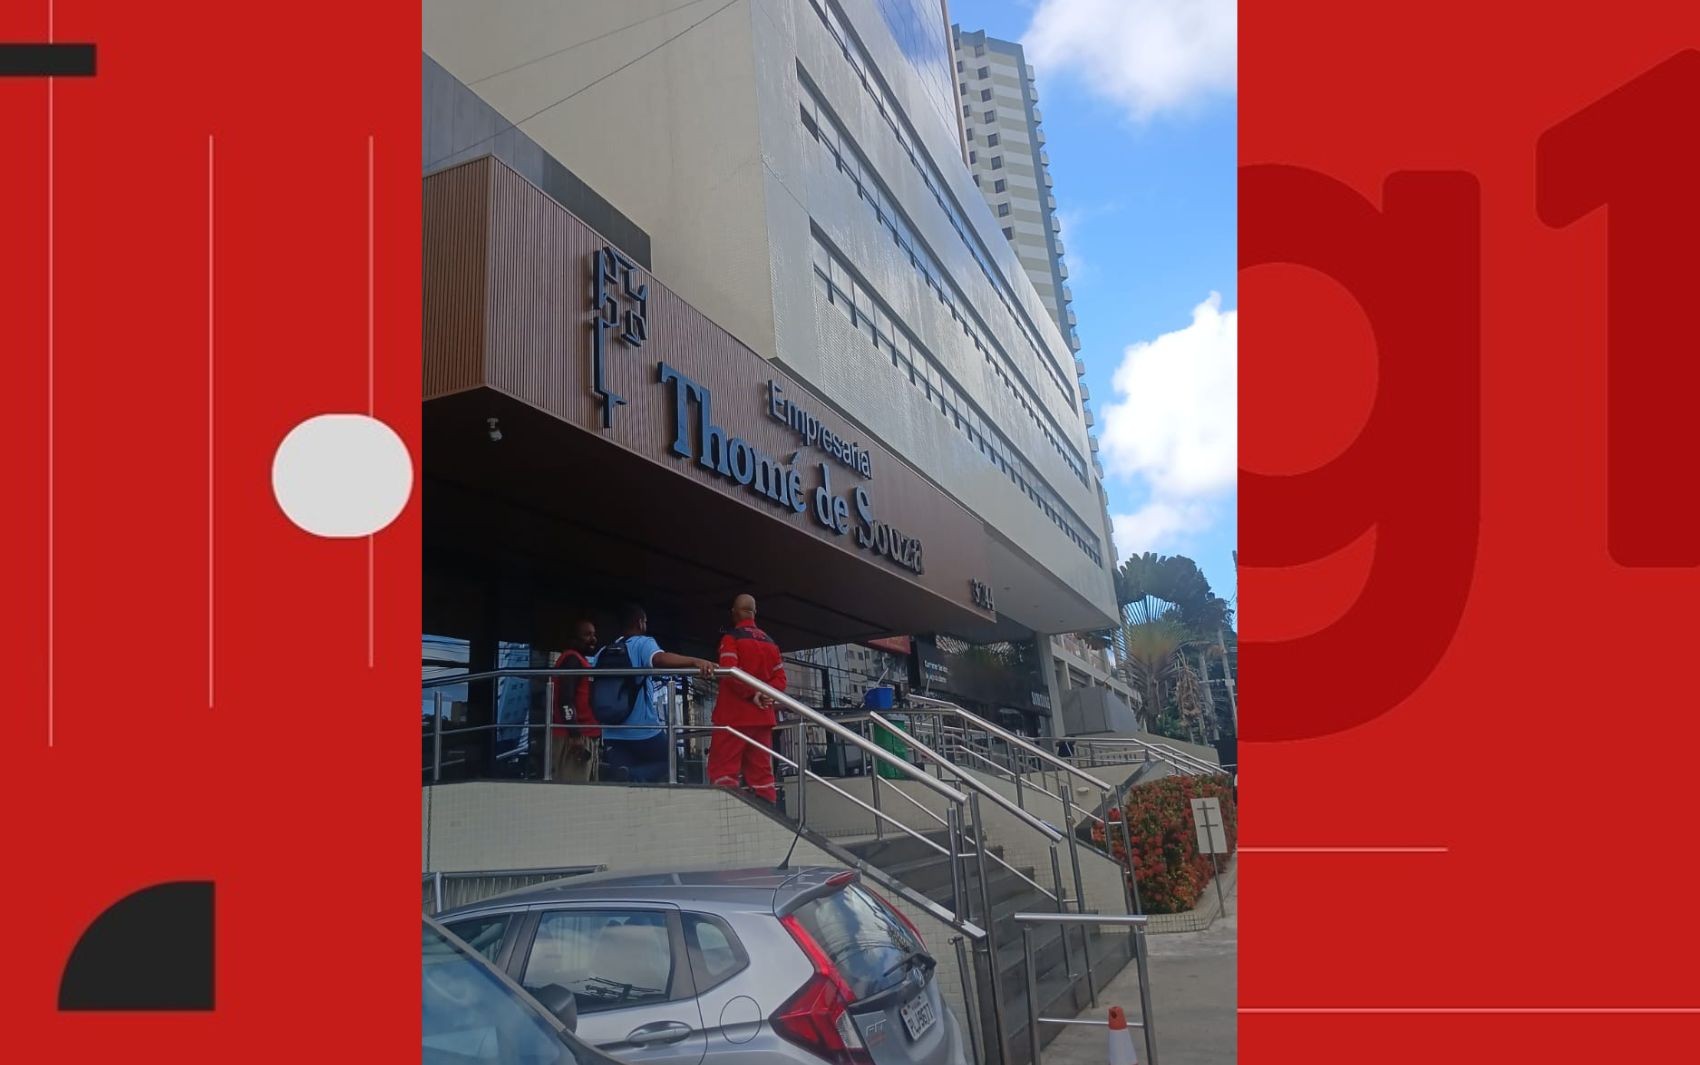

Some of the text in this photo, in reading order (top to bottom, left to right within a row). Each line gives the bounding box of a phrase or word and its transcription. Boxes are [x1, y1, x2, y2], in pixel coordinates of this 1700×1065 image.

[658, 361, 923, 575] Thomé de Souza
